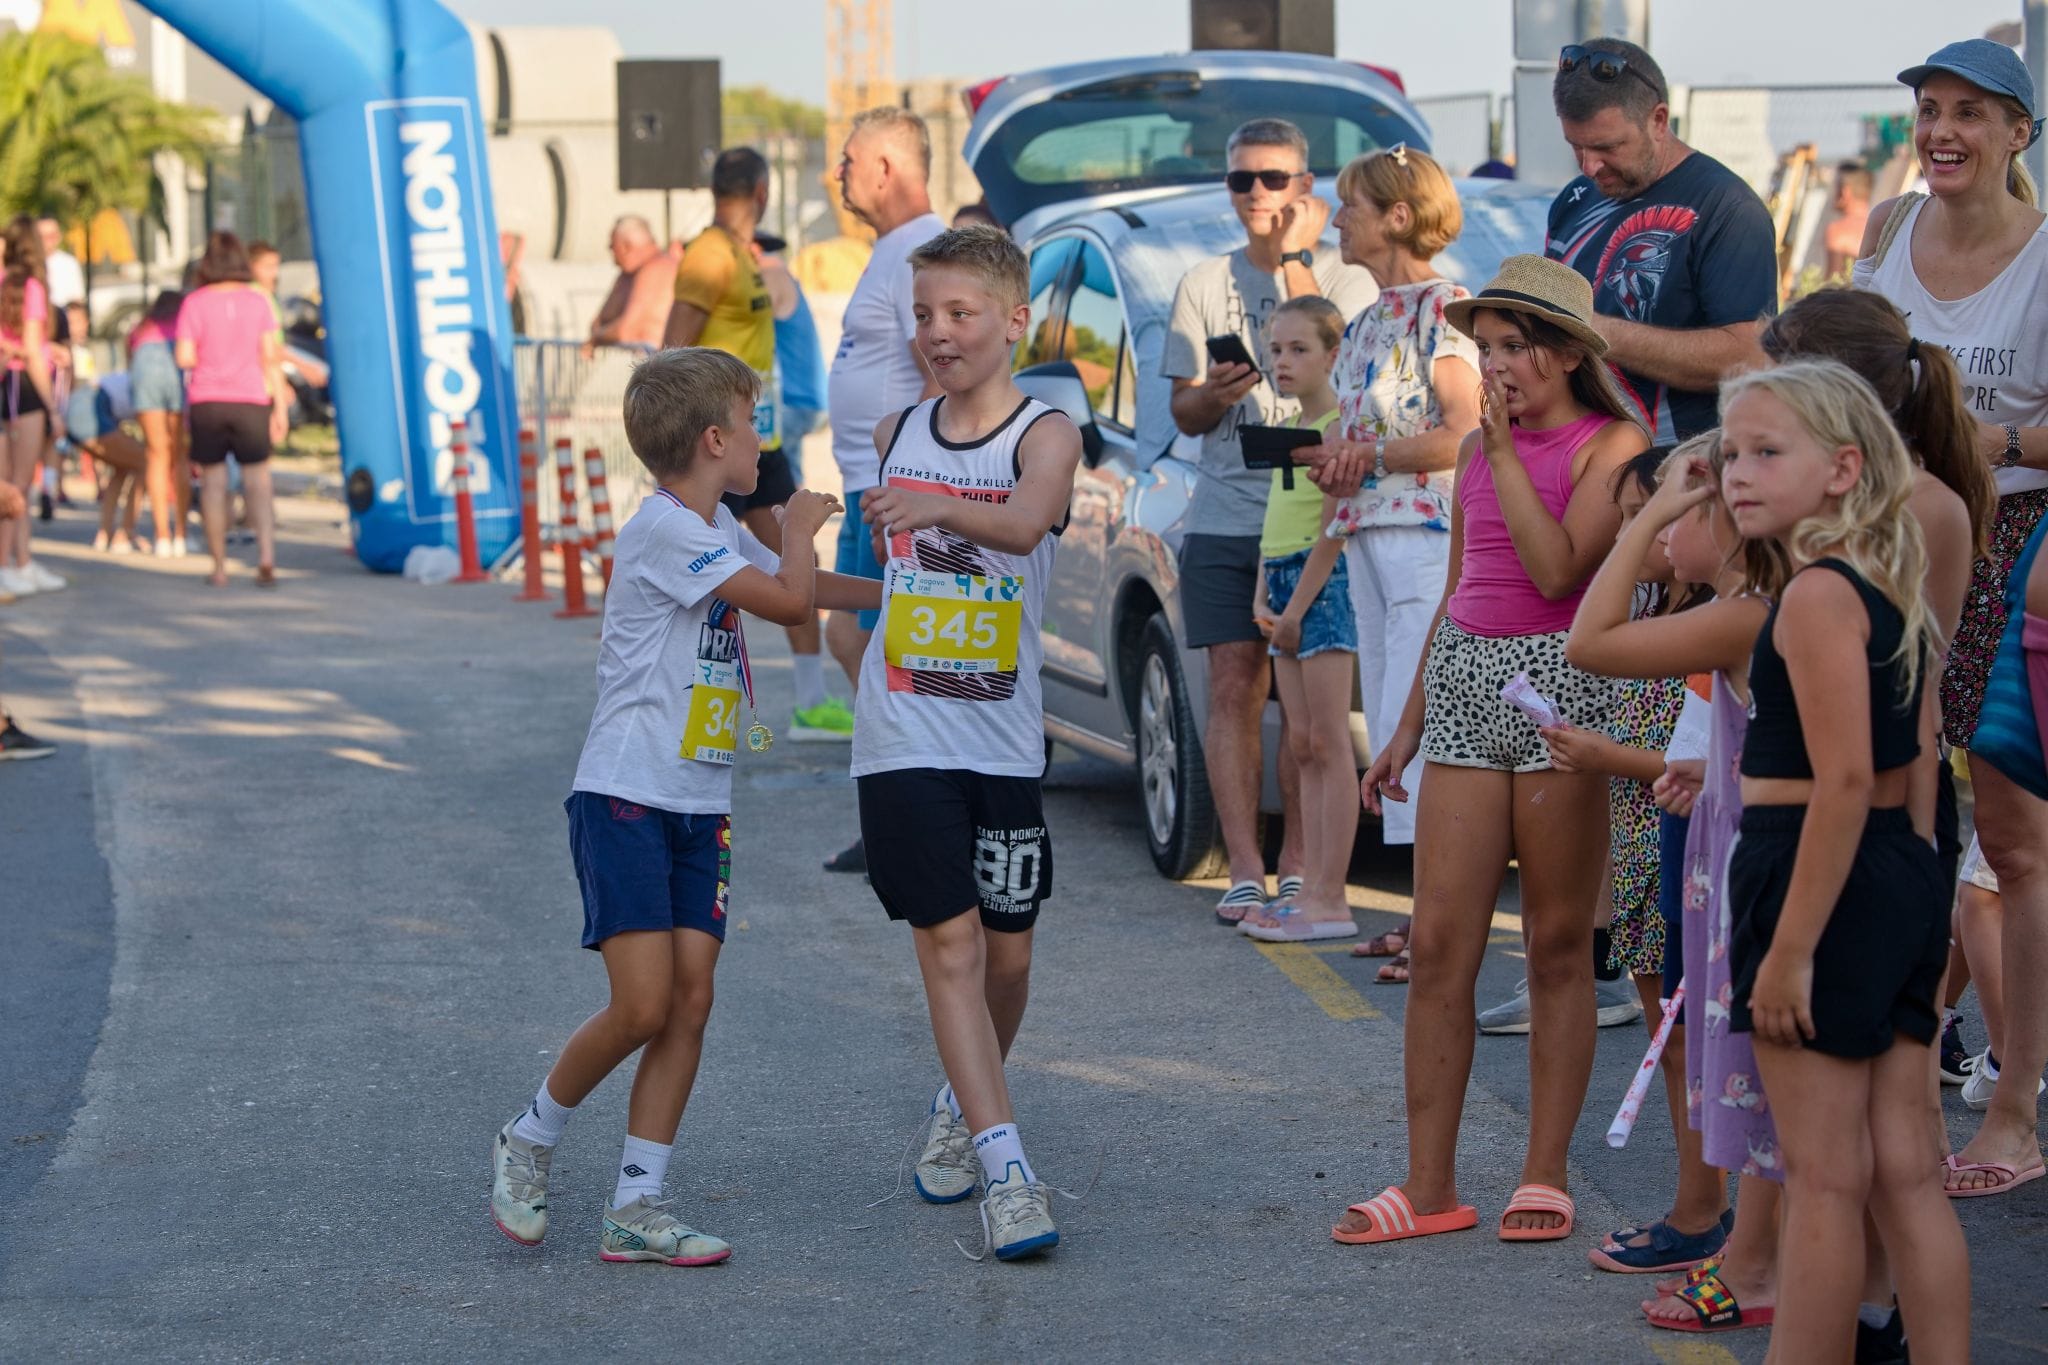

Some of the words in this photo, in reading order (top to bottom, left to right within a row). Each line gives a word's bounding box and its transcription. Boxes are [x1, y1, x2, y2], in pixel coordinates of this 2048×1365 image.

[1968, 346, 2017, 377] FIRST
[687, 546, 729, 573] Wilson
[909, 605, 999, 649] 345
[1010, 827, 1046, 841] MONICA
[973, 839, 1042, 901] 80
[983, 900, 1033, 914] CALIFORNIA
[991, 1129, 1008, 1140] ON
